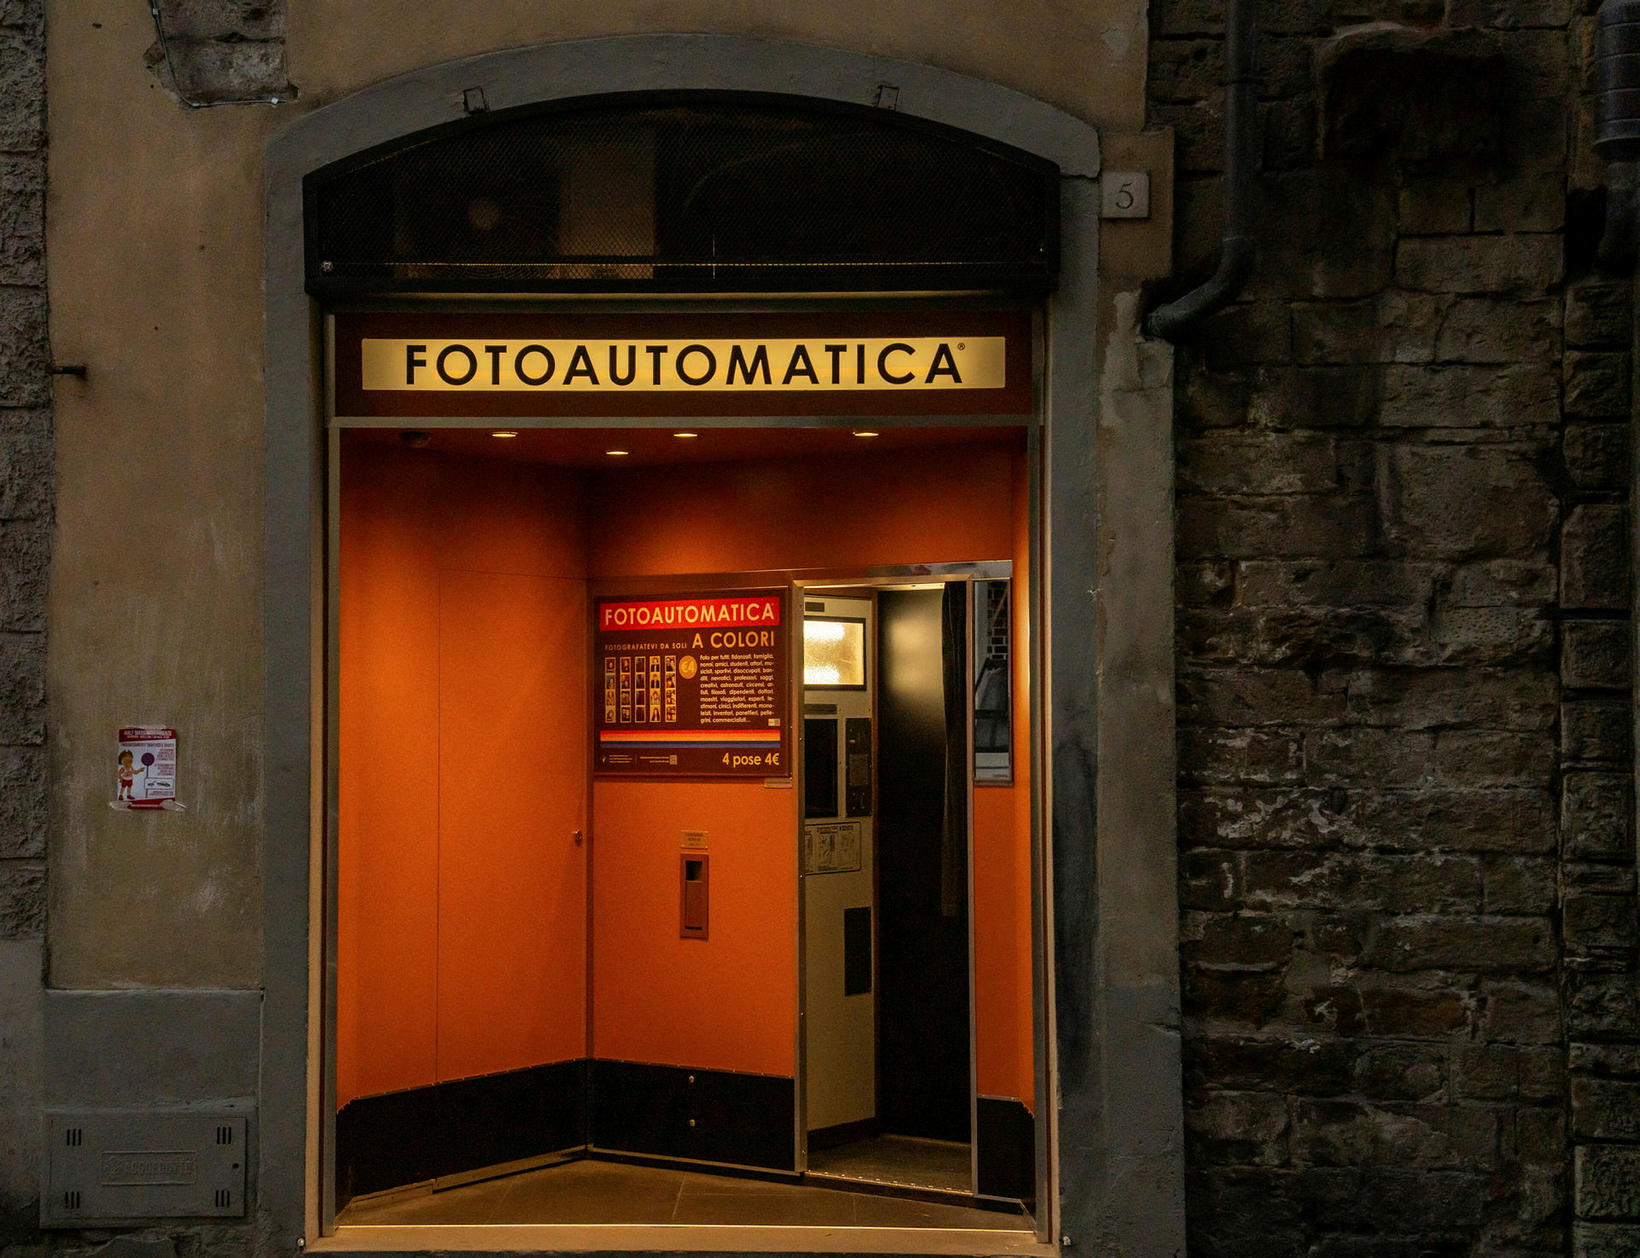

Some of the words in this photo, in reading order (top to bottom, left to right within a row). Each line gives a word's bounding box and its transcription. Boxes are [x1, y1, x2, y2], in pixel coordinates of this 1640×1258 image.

[1116, 182, 1134, 210] 5
[605, 602, 775, 626] FOTOAUTOMATICA
[692, 633, 704, 649] A
[710, 631, 775, 649] COLORI
[722, 752, 730, 764] 4
[733, 755, 762, 768] pose
[764, 752, 780, 765] 4€
